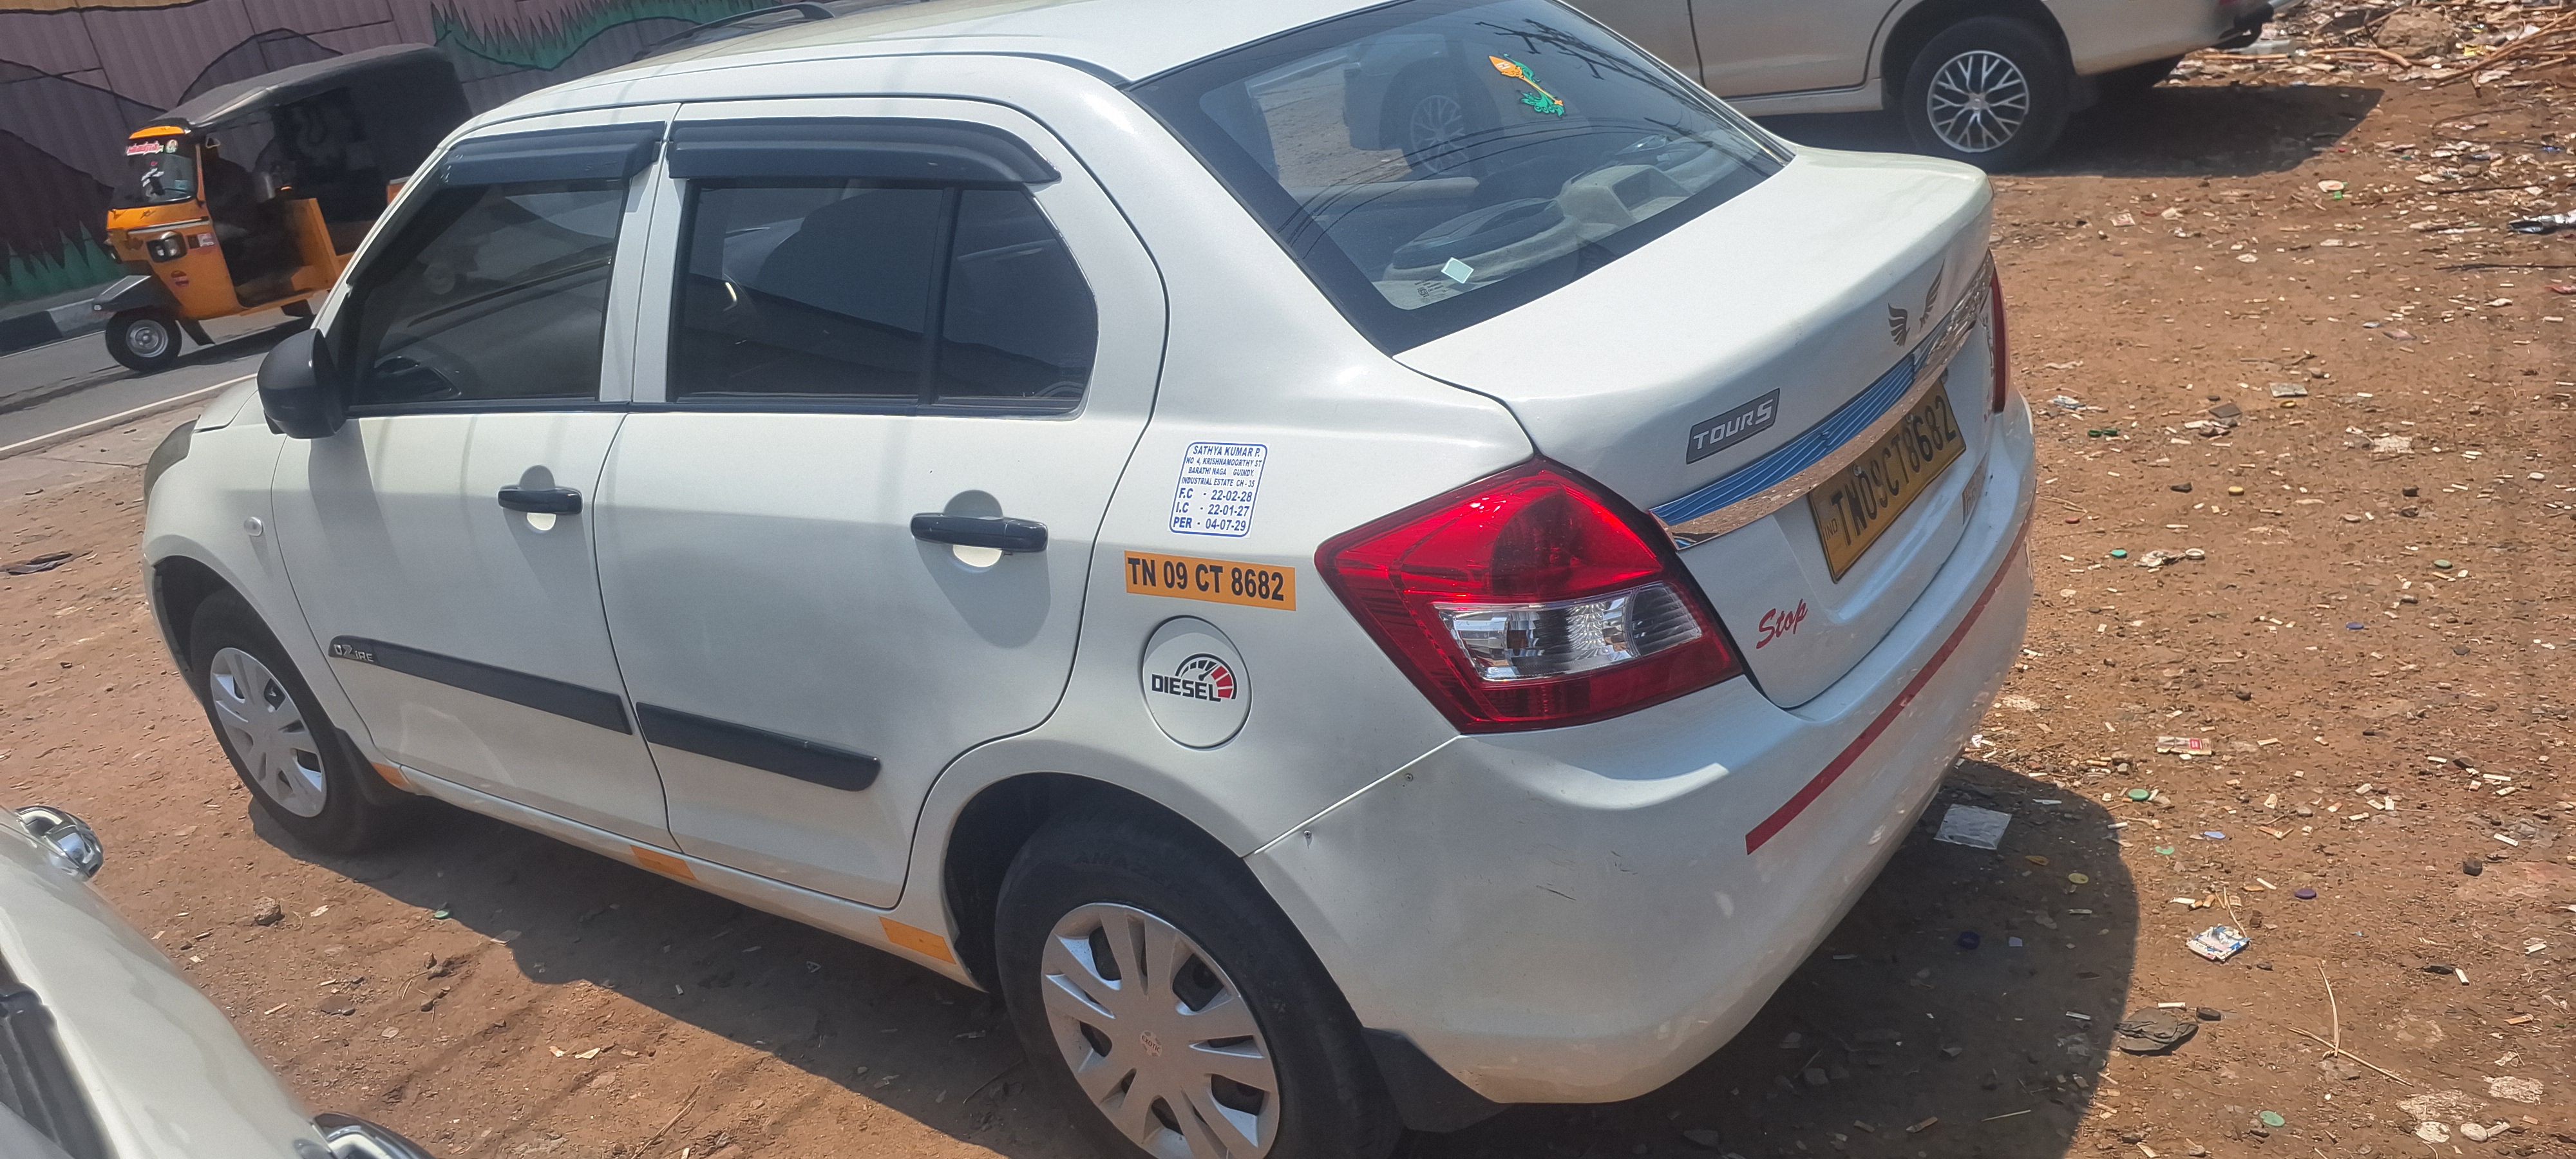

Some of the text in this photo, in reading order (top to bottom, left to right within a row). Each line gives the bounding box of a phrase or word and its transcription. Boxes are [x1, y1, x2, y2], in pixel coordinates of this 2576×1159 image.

[1193, 446, 1222, 455] SATHYA
[1224, 446, 1253, 457] KUMAR
[1202, 458, 1254, 467] KRISHNAMOORTHY
[1188, 466, 1211, 475] BARATHI
[1830, 395, 1956, 546] TN09CT8682
[1181, 476, 1212, 485] INDUSTRIAL
[1213, 478, 1234, 487] ESTATE
[1179, 487, 1194, 499] F.C
[1211, 489, 1253, 502] 22-02-28
[1175, 502, 1189, 513] I.C
[1208, 504, 1250, 517] 22-01-27
[1173, 516, 1192, 529] PER
[1205, 518, 1246, 531] 04-07-29
[1824, 518, 1838, 541] IND
[1128, 557, 1284, 601] TN 09 CT 8682
[1756, 598, 1808, 649] Stop
[1151, 674, 1222, 702] DIESEL
